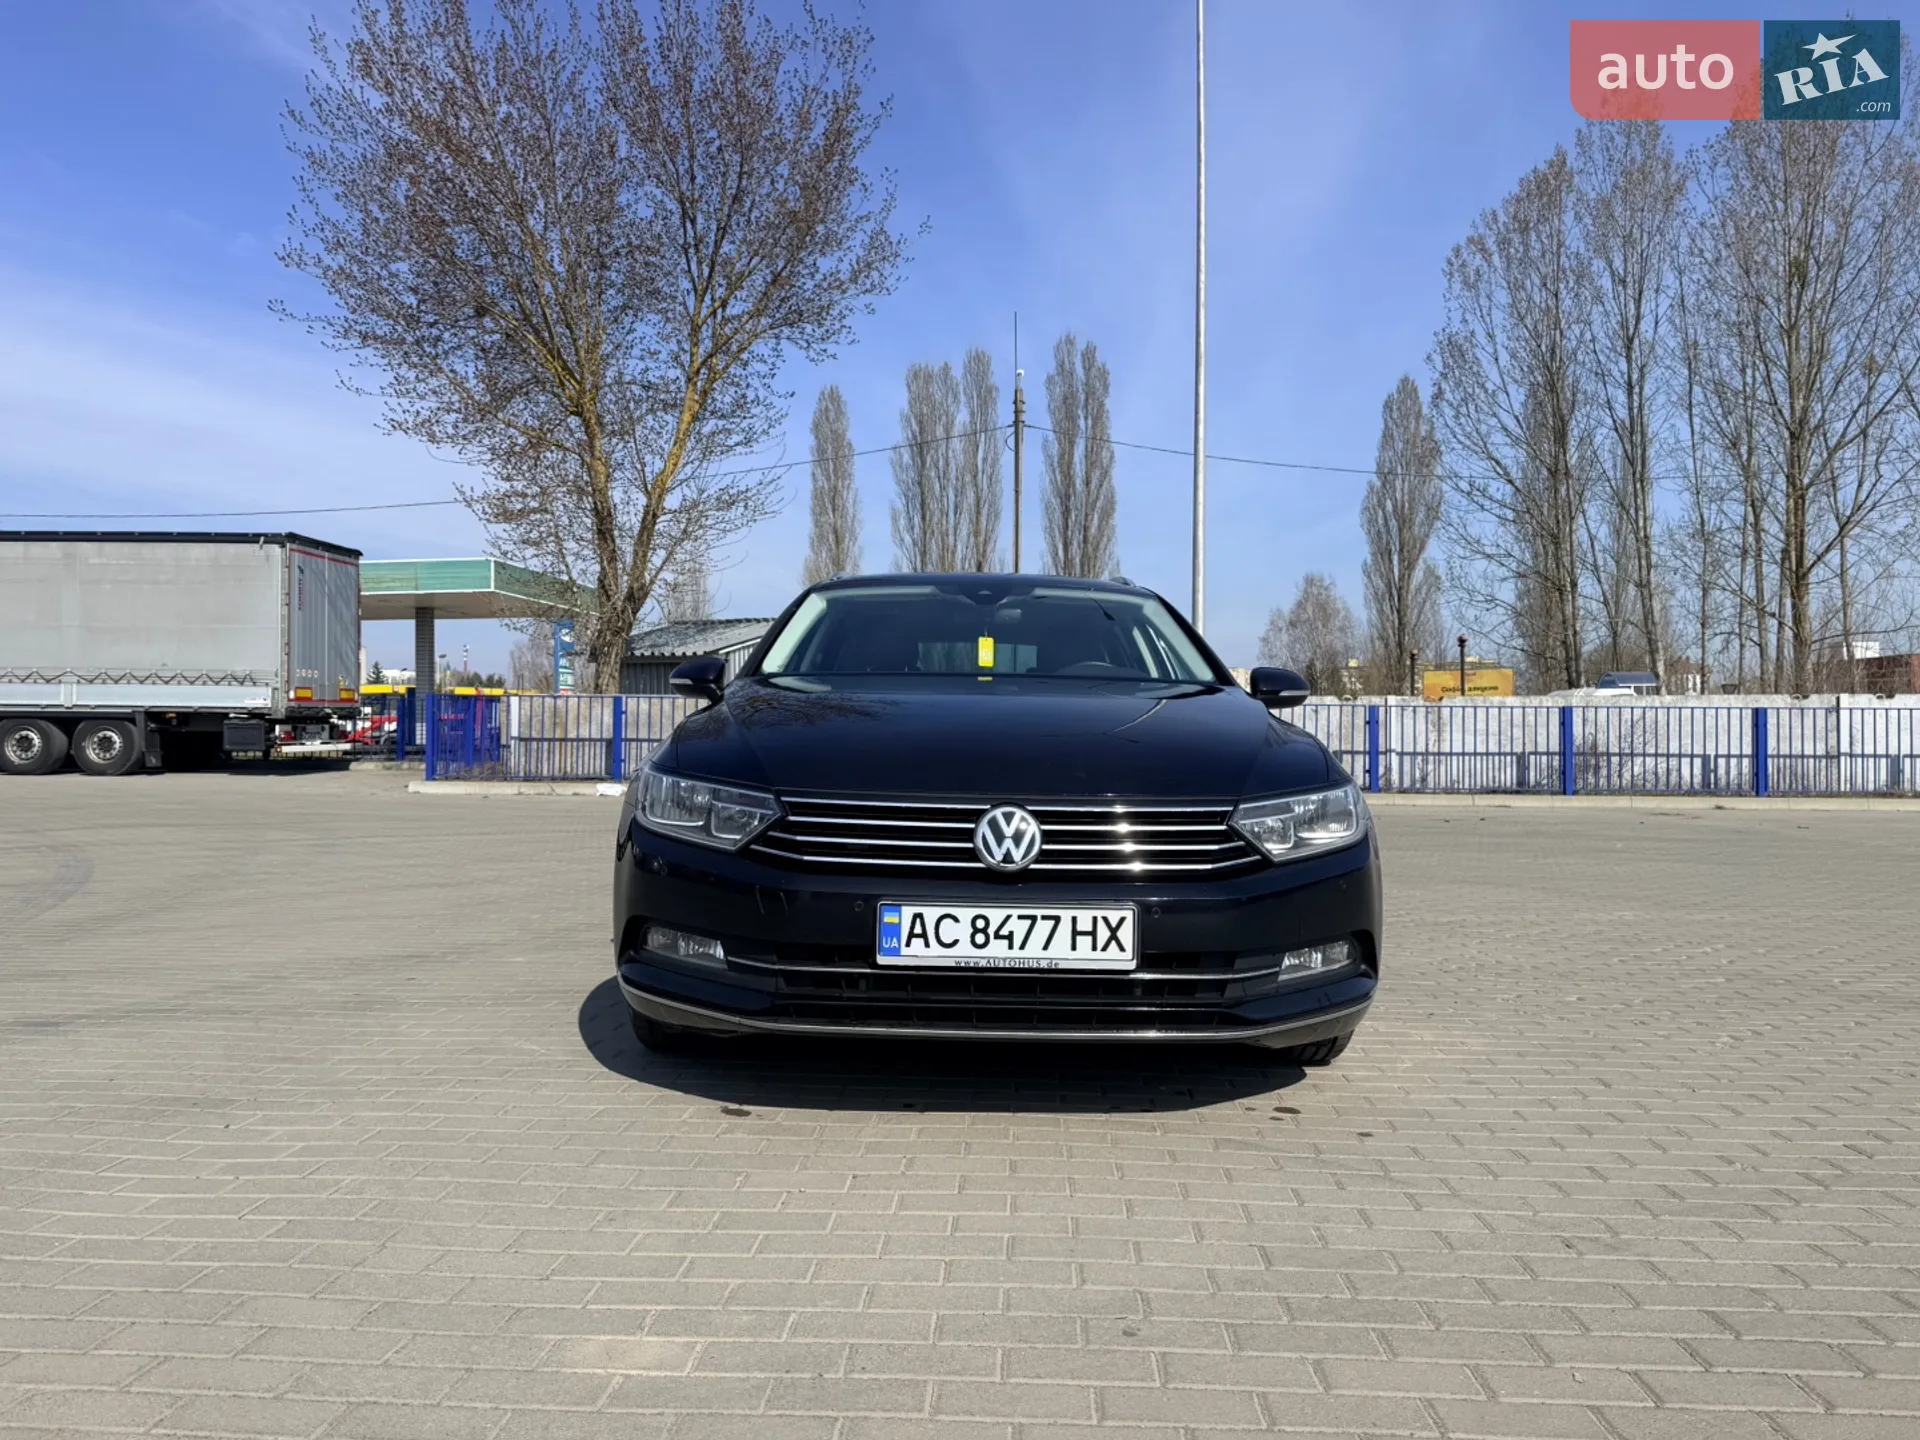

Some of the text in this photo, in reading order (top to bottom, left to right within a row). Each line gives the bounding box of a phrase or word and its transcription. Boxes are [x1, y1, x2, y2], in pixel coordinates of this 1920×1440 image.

[904, 912, 1128, 953] AC 8477 HX
[882, 936, 900, 949] UA
[954, 958, 1060, 969] www.AUTOHUS.de
